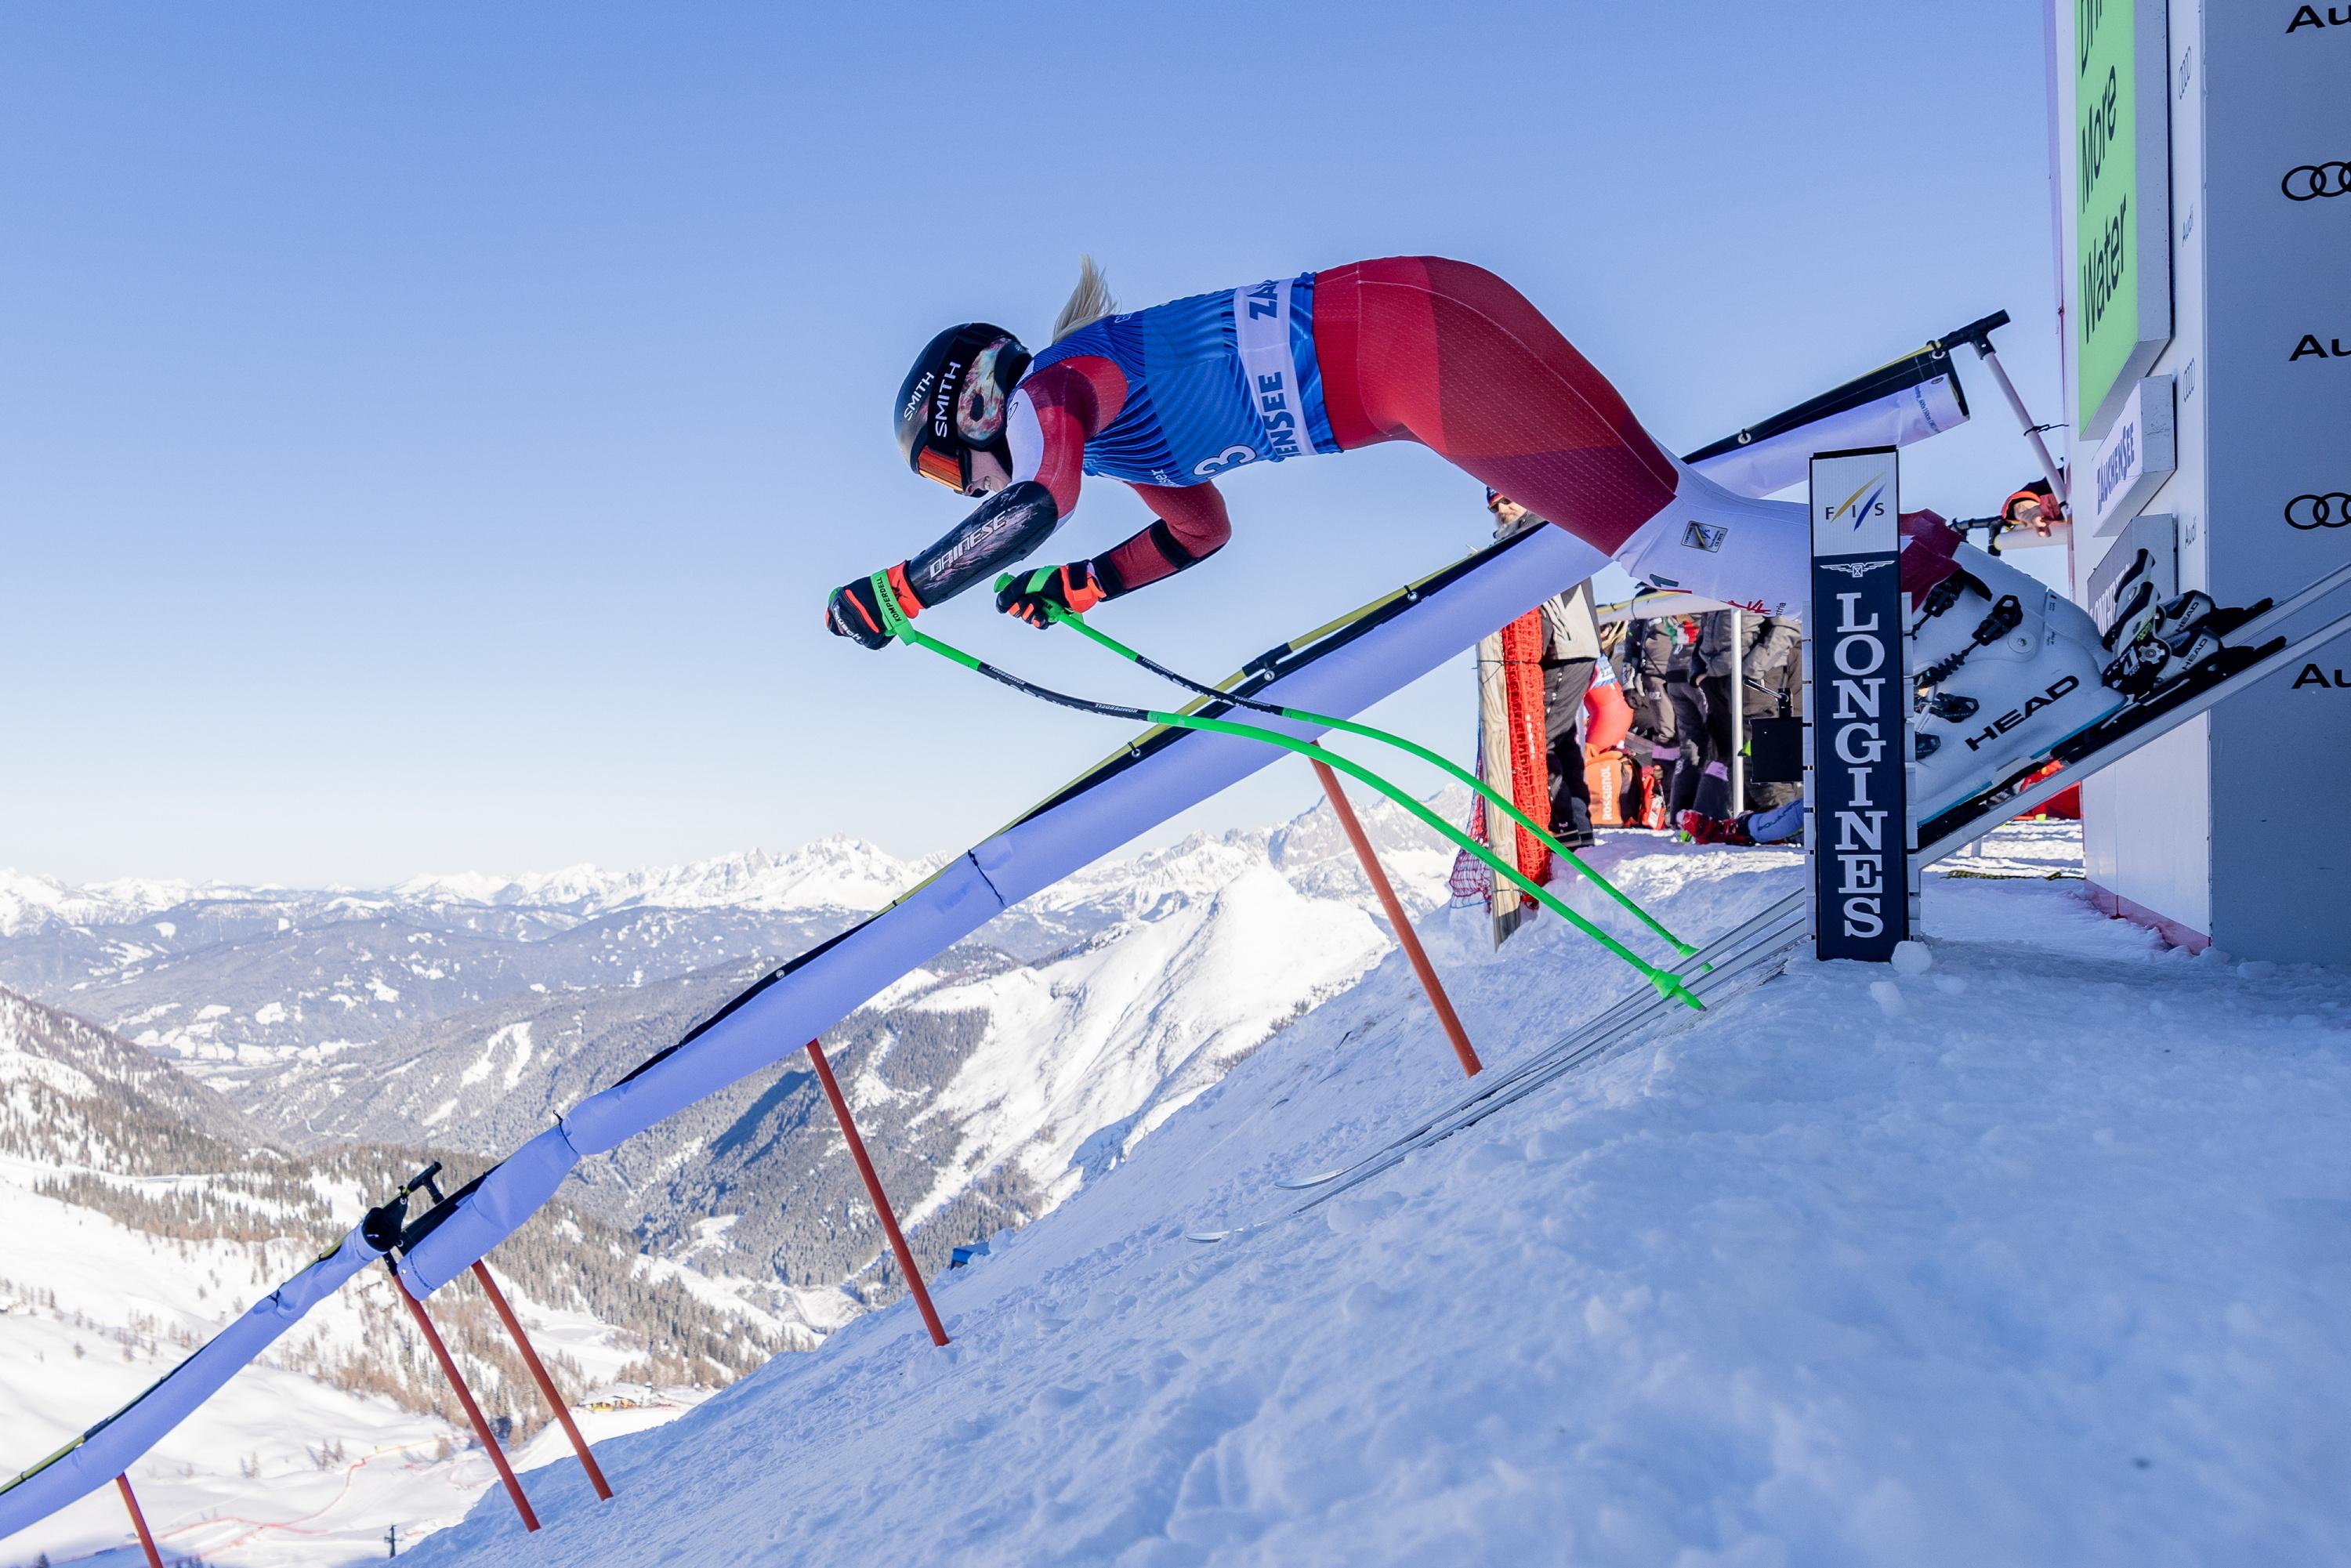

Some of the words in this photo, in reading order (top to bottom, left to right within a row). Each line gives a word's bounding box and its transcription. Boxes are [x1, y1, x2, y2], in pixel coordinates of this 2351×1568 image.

[2081, 65, 2116, 214] More
[2084, 194, 2126, 344] Water
[904, 371, 935, 421] SMITH
[935, 361, 962, 438] SMITH
[1258, 371, 1301, 458] ENSEE
[1194, 444, 1257, 479] 3
[2097, 421, 2135, 516] ZAUCHENSEE
[1826, 502, 1885, 520] FIS
[929, 510, 1006, 578] DAINESE
[876, 577, 902, 622] KOMPERDELL
[2175, 602, 2199, 633] HEAD
[988, 666, 1026, 686] KOMPERDELL
[2182, 639, 2208, 671] HEAD
[1095, 703, 1139, 714] KOMPERDELL
[1965, 675, 2080, 751] HEAD
[1600, 764, 1613, 820] ROSSIGNOL
[1833, 591, 1888, 939] LONGINES
